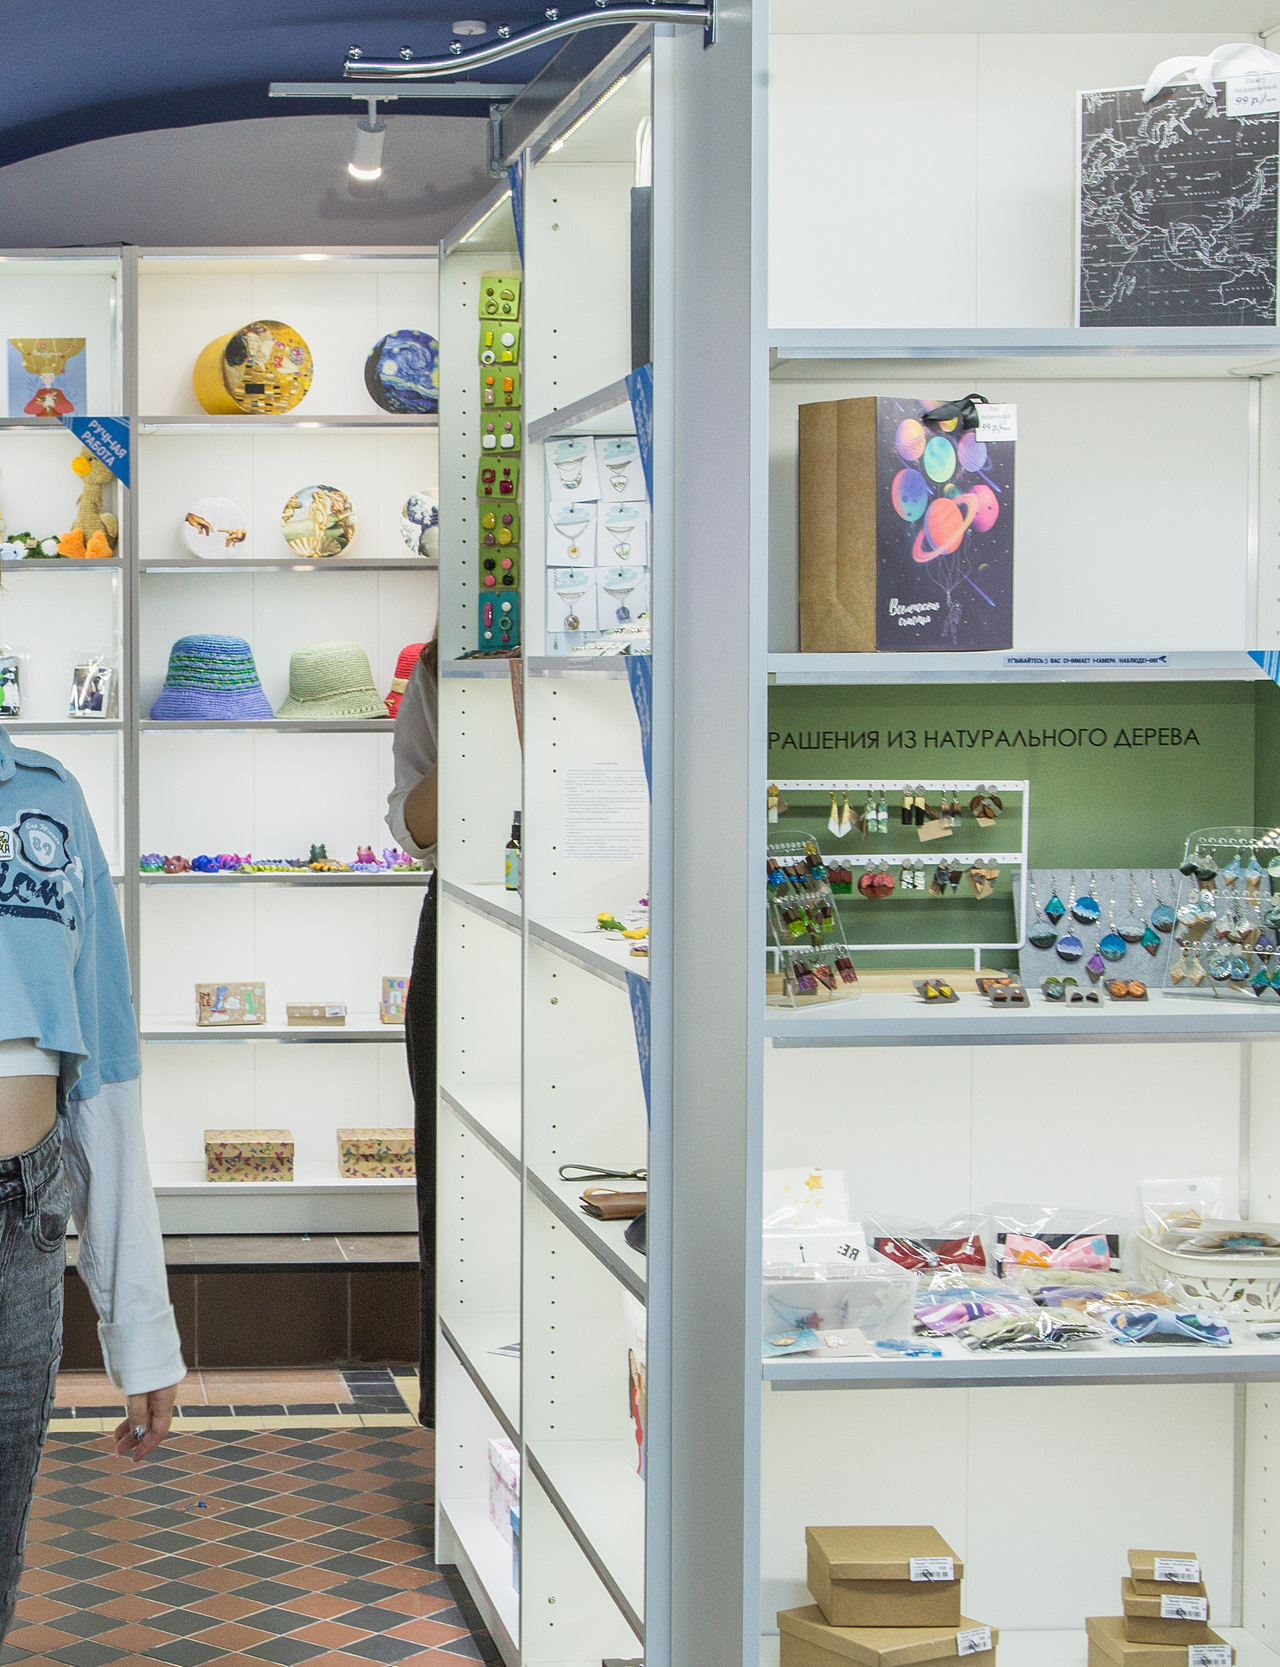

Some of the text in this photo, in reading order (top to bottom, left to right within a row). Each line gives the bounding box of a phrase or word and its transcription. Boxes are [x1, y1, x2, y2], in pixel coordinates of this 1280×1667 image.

[1236, 96, 1249, 105] 99
[81, 431, 115, 467] РАБОТА
[87, 419, 128, 459] РУЧНАЯ
[887, 730, 917, 749] ИЗ
[924, 728, 1109, 749] НАТУРАЛЬНОГО
[1113, 727, 1202, 749] ДЕРЕВА
[32, 836, 53, 856] 89
